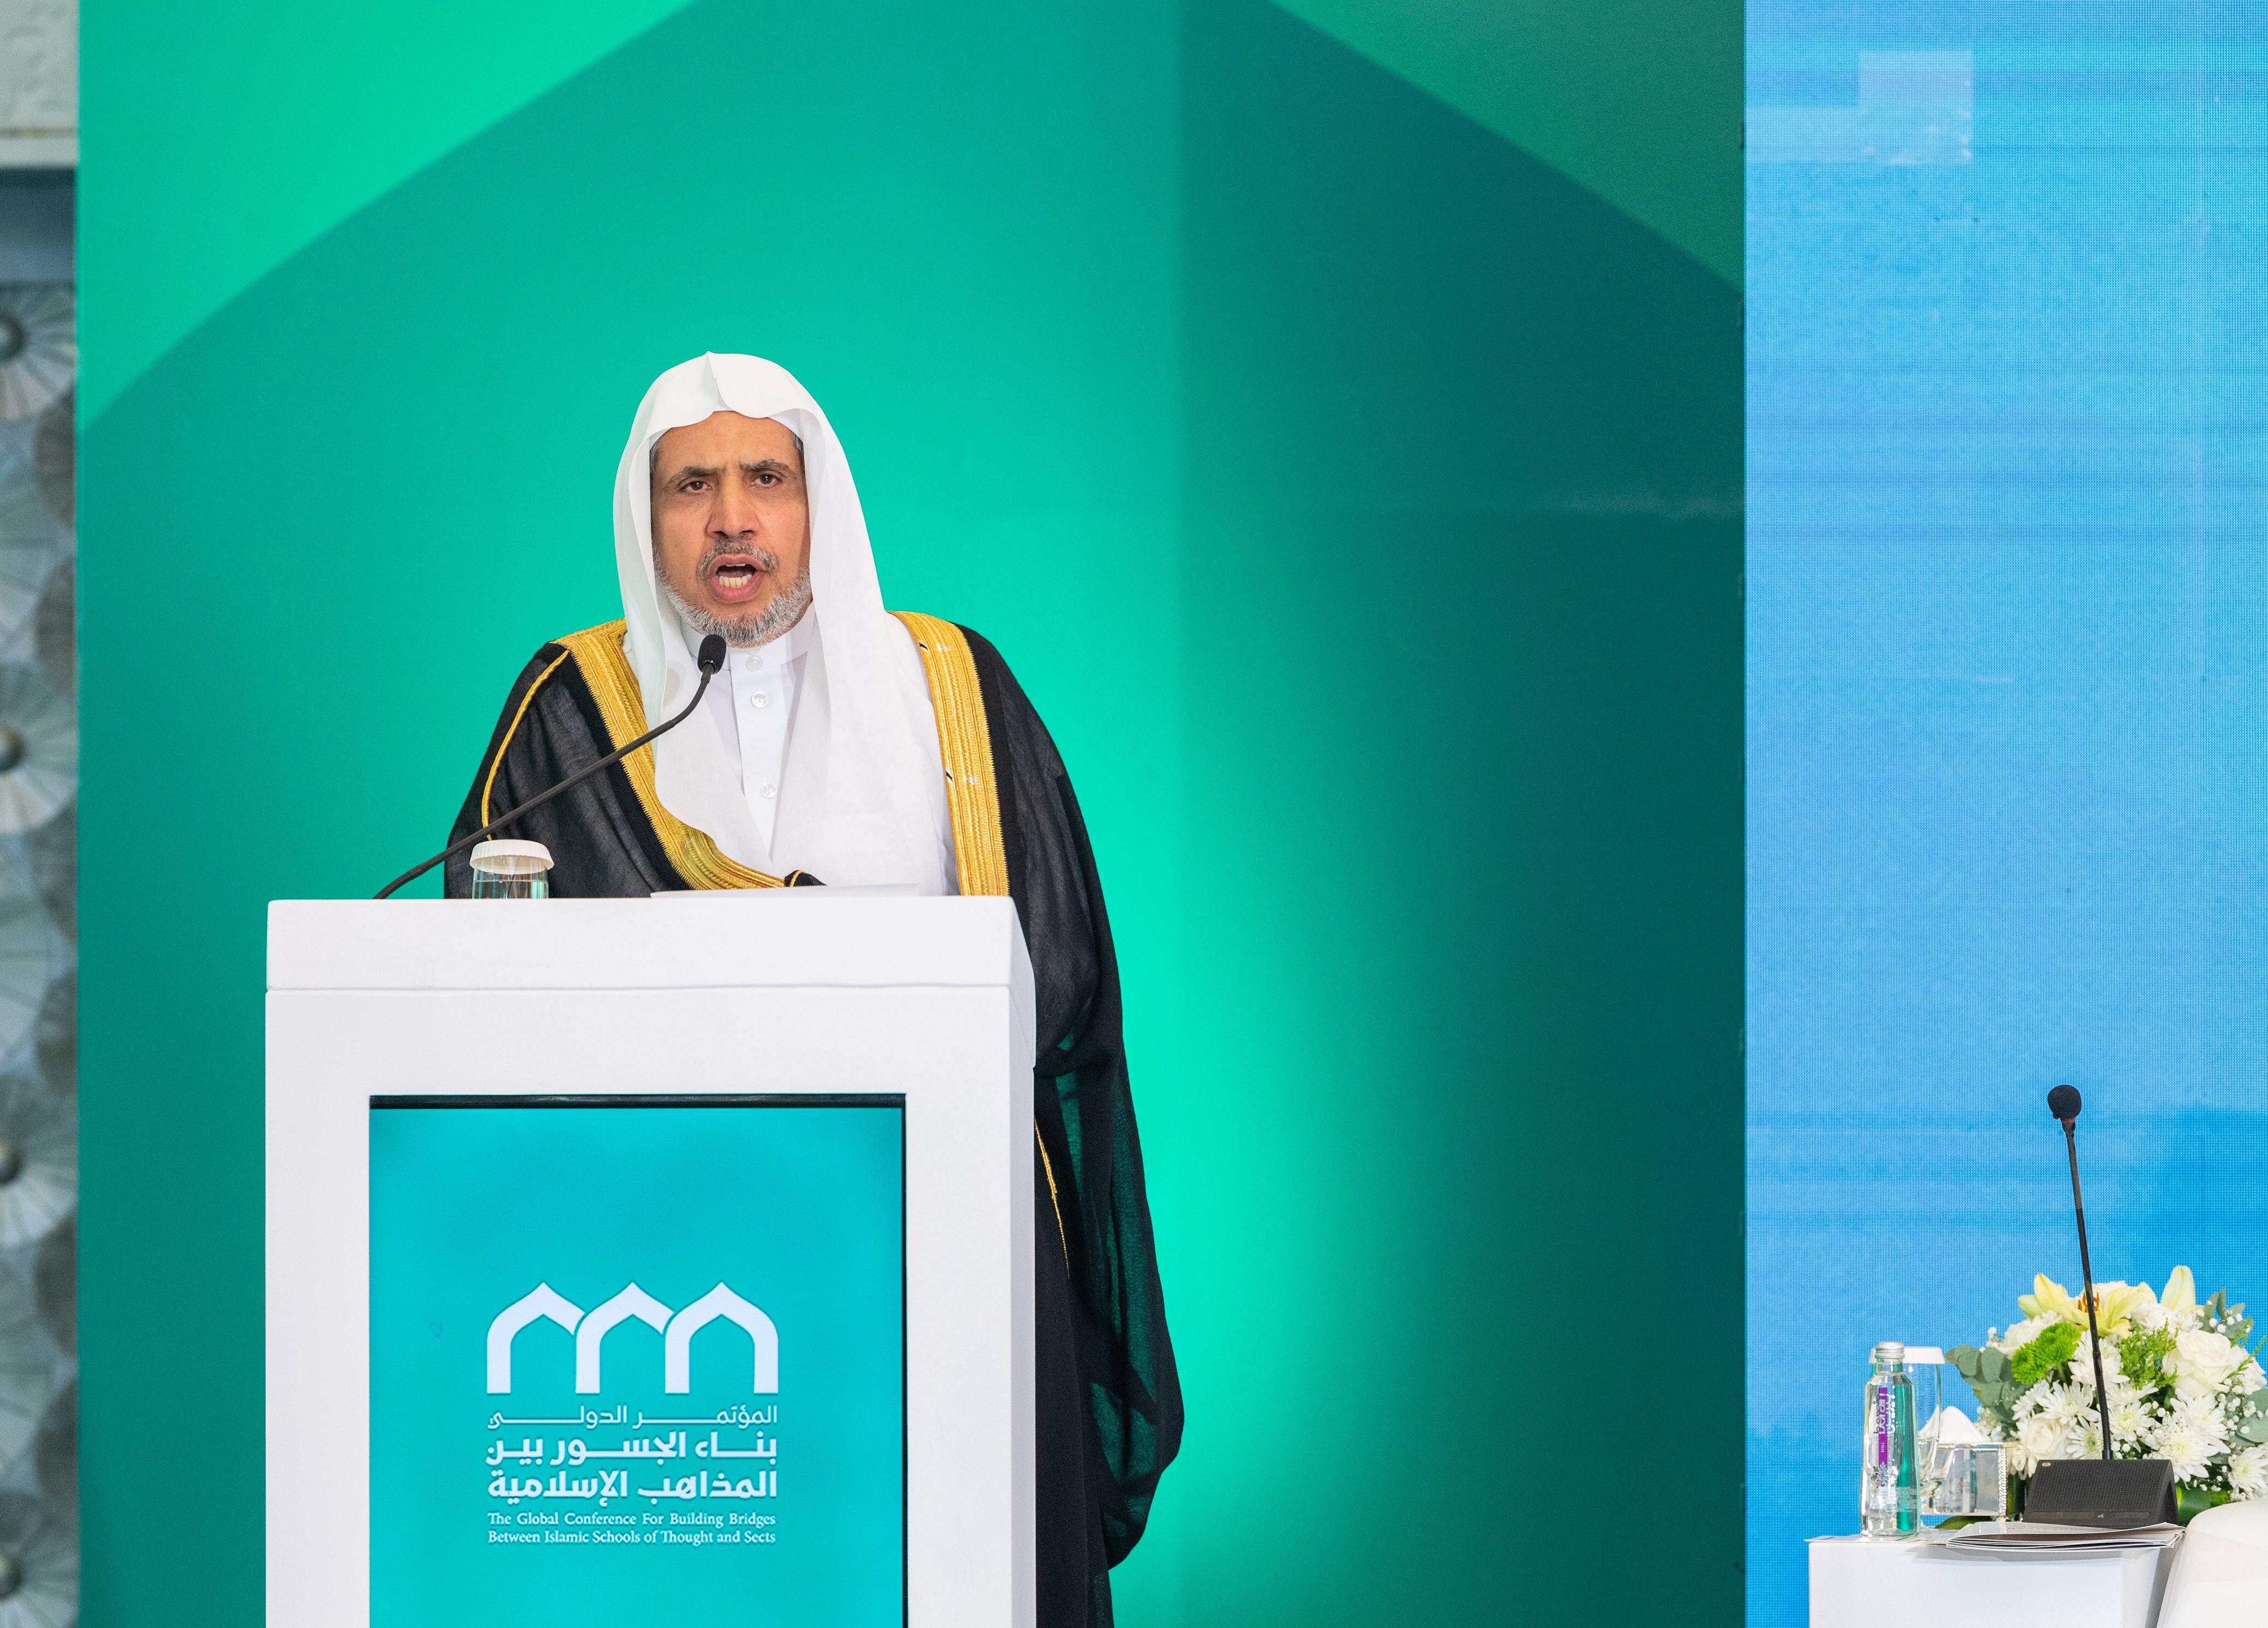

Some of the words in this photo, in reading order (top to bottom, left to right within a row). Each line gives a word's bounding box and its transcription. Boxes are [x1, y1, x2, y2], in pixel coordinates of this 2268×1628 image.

[487, 1405, 627, 1430] الدولي
[632, 1404, 777, 1430] المؤتمر
[486, 1438, 544, 1466] بين
[550, 1431, 686, 1466] الجسور
[695, 1431, 777, 1465] بناء
[488, 1469, 628, 1508] الإسلامية
[637, 1470, 777, 1505] المذاهب
[488, 1512, 511, 1525] The
[517, 1512, 559, 1525] Global
[564, 1512, 636, 1525] Conference
[643, 1512, 664, 1525] For
[670, 1512, 723, 1528] Building
[729, 1512, 775, 1528] Bridges
[488, 1530, 540, 1543] Between
[545, 1530, 589, 1543] Islamic
[593, 1530, 641, 1543] Schools
[644, 1530, 659, 1543] of
[661, 1530, 713, 1546] Thought
[717, 1530, 740, 1543] and
[744, 1531, 776, 1543] Sects
